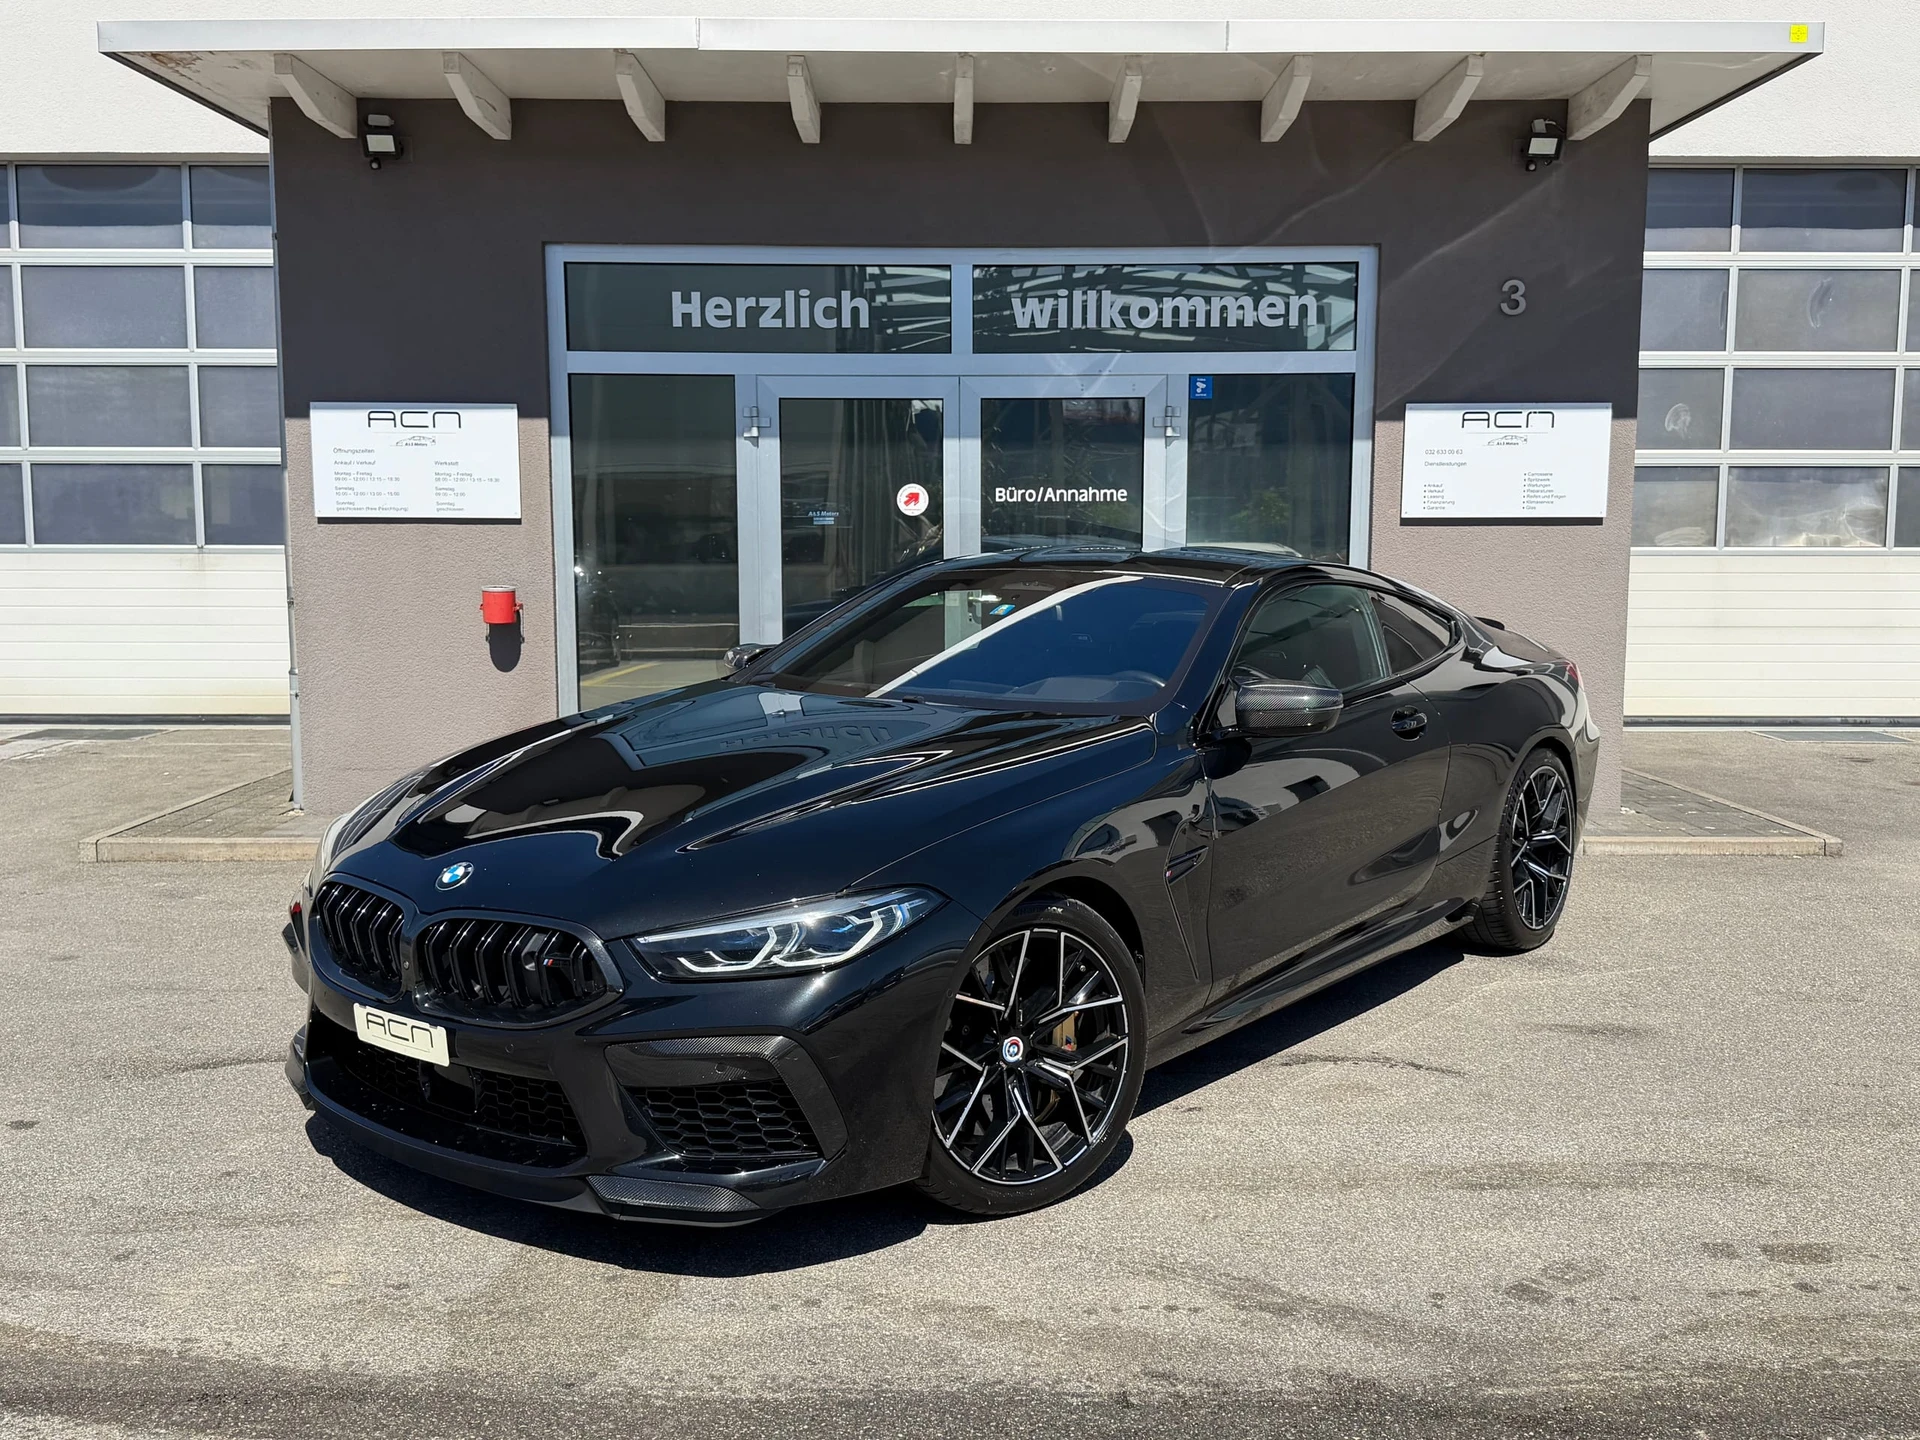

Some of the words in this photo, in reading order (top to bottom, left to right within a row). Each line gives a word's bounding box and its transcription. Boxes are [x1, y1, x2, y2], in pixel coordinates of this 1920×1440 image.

[671, 288, 870, 329] Herzlich
[1010, 288, 1318, 329] willkommen
[1501, 279, 1526, 316] 3
[333, 447, 375, 455] Öffnungszeiten
[995, 487, 1128, 502] Büro/Annahme
